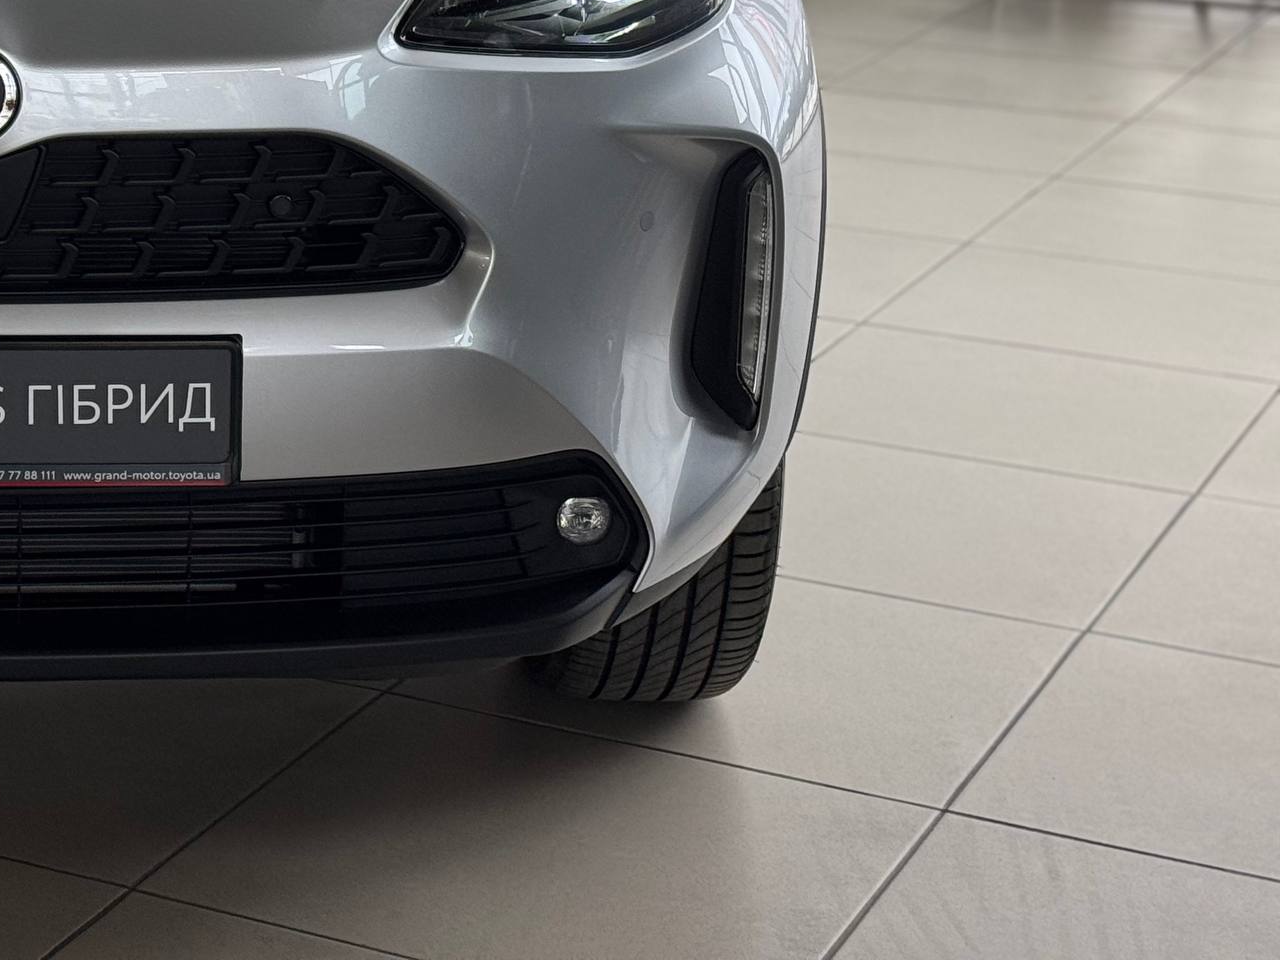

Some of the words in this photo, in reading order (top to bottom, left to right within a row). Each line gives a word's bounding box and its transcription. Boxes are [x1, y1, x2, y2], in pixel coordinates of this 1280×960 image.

[28, 383, 216, 433] ГІБРИД
[7, 470, 22, 481] 77
[23, 470, 38, 481] 88
[40, 470, 56, 481] 111
[63, 470, 222, 482] www.grand-motor.toyota.ua
